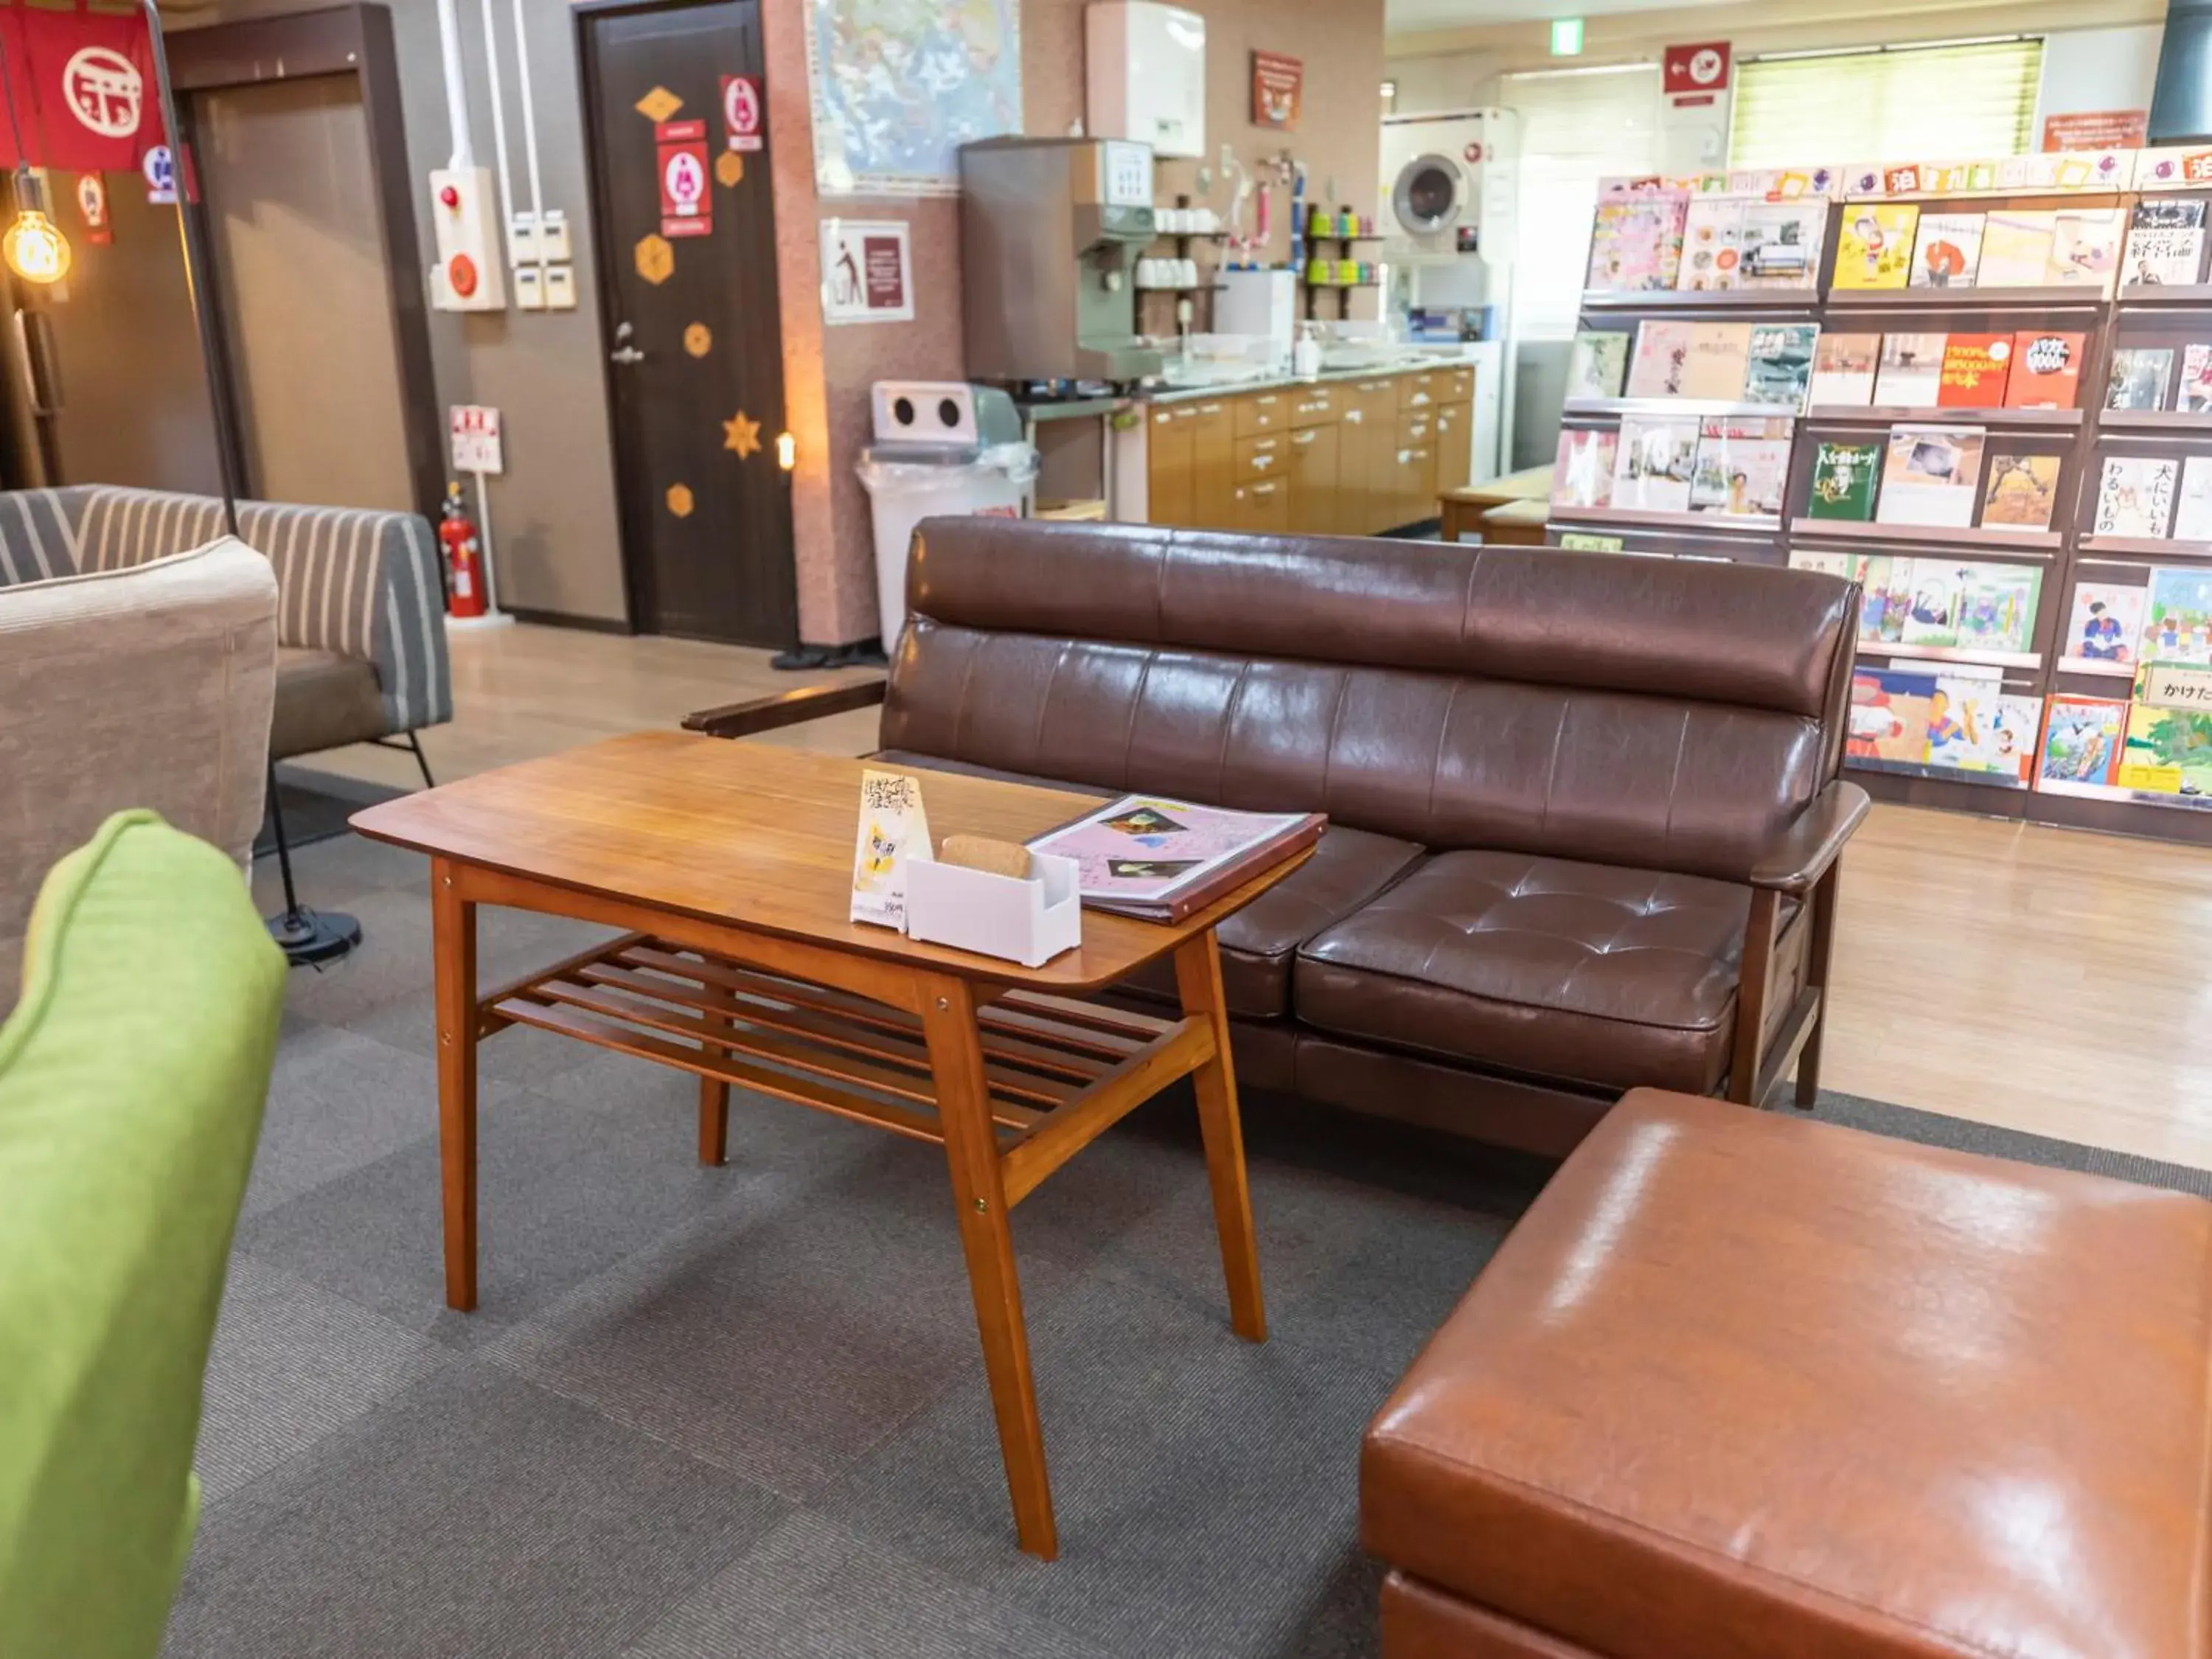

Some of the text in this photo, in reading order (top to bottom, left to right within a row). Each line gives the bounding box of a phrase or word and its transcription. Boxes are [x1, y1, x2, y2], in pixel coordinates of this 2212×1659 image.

[2099, 462, 2123, 532] わるいもの
[2146, 464, 2173, 539] 犬にいいも
